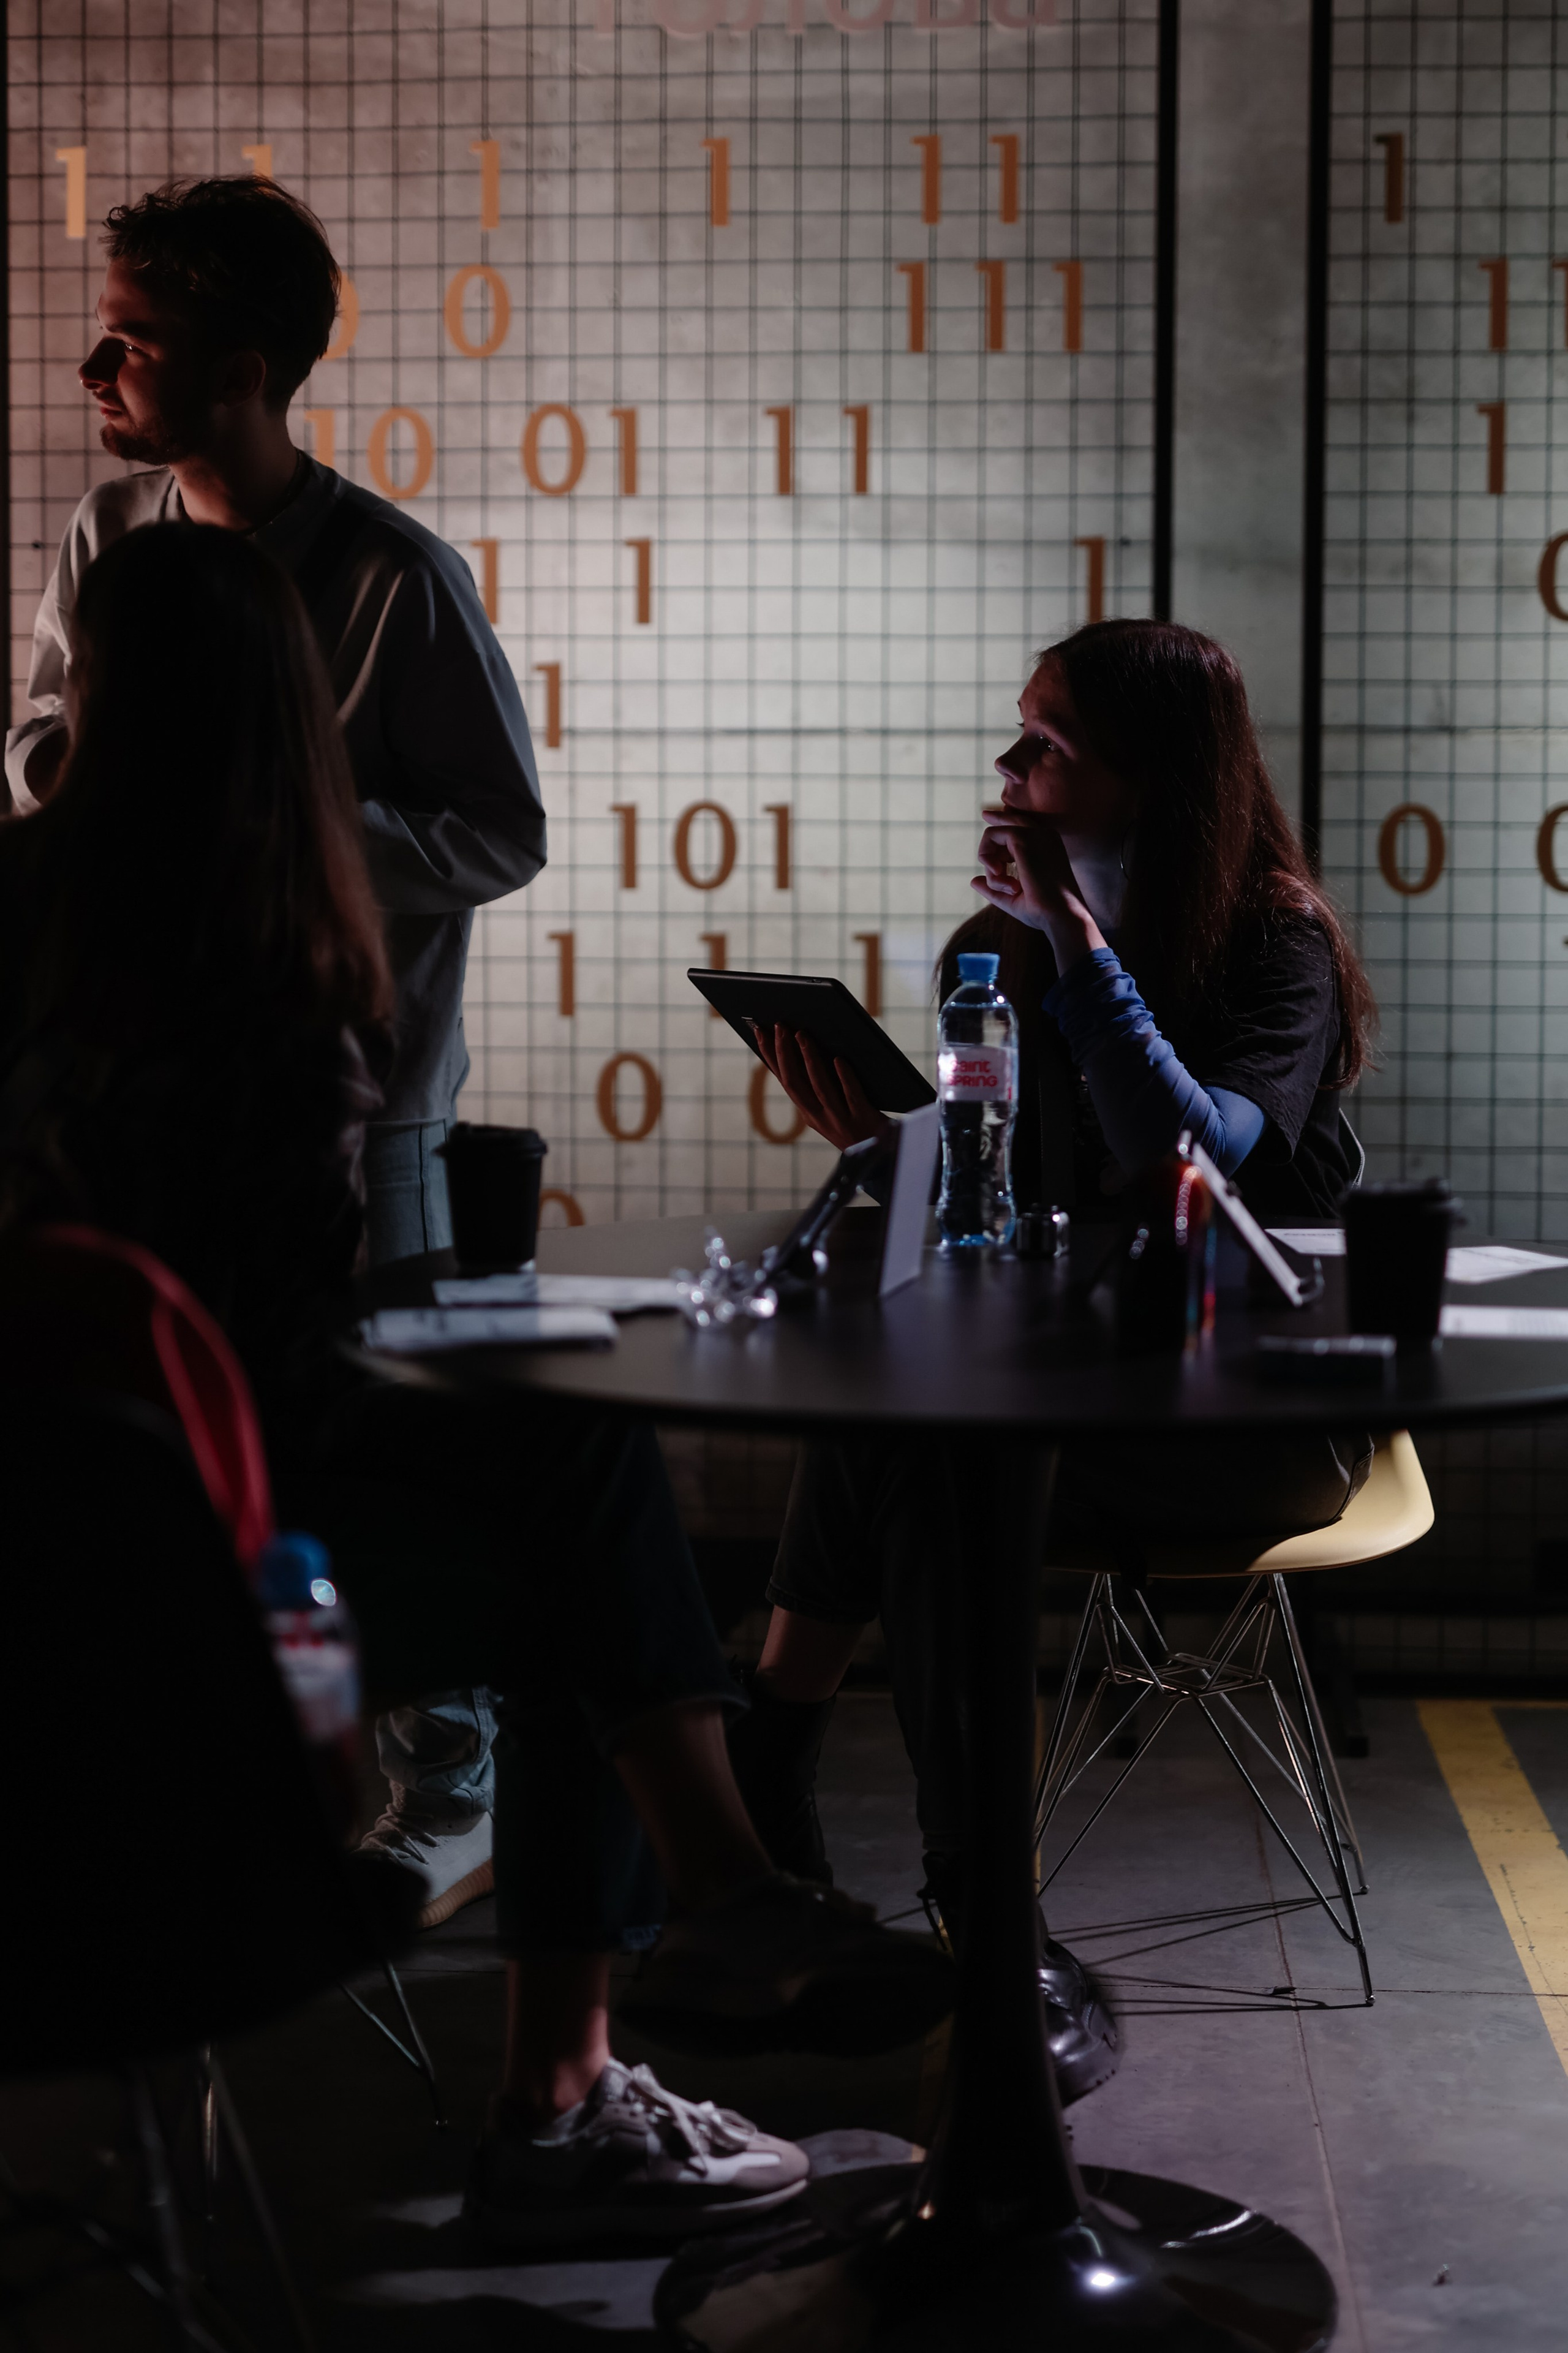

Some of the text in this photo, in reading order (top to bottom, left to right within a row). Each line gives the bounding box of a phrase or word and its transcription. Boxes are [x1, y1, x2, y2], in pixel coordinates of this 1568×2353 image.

[56, 146, 86, 238] 1
[470, 140, 501, 229] 1
[702, 137, 731, 227] 1
[1374, 132, 1404, 223] 1
[1477, 402, 1506, 494] 1
[625, 537, 651, 624] 1
[1074, 536, 1105, 624] 1
[532, 662, 562, 749] 1
[547, 930, 575, 1017] 1
[853, 932, 881, 1018] 1
